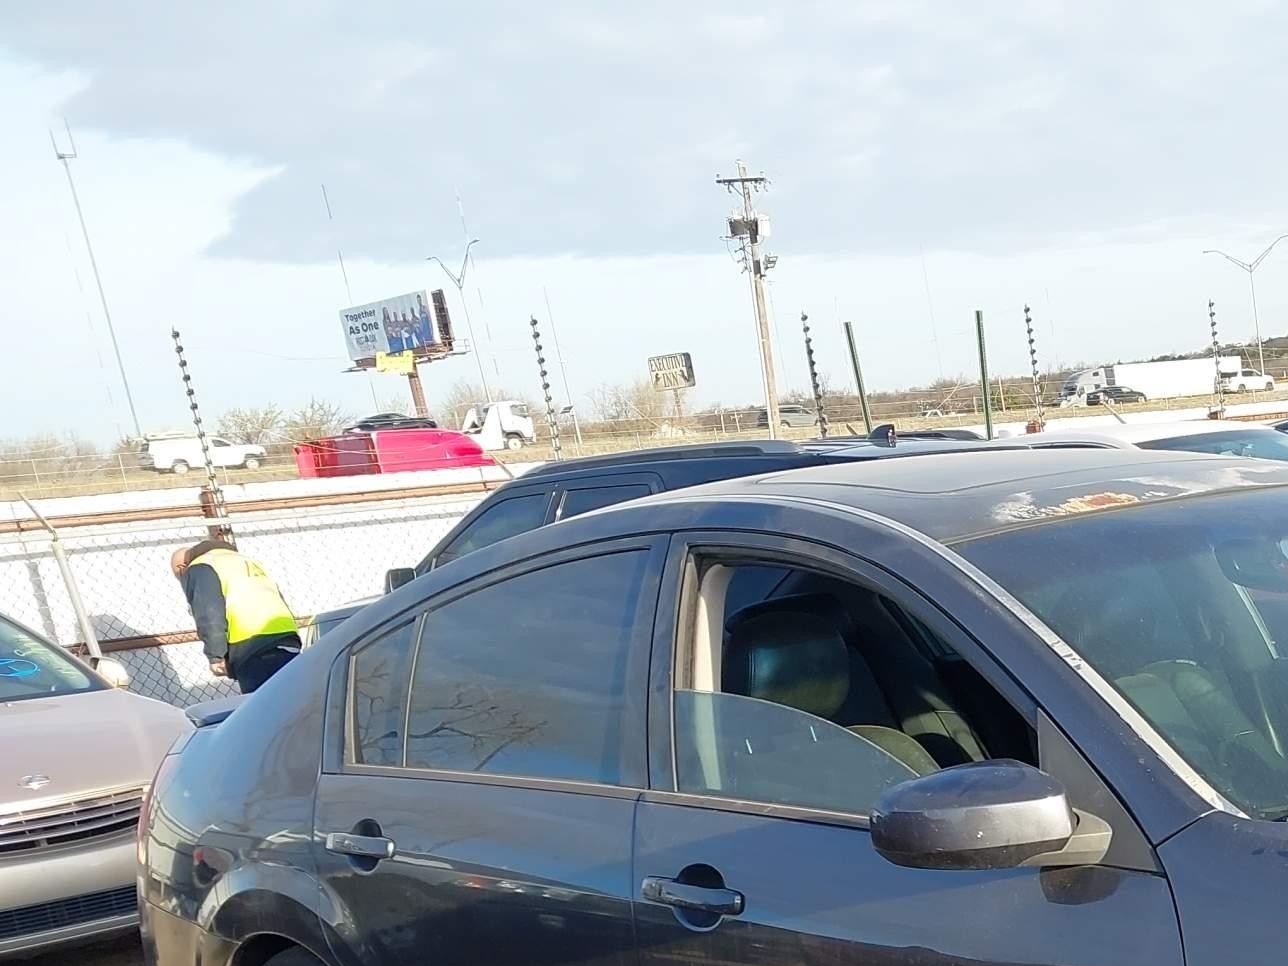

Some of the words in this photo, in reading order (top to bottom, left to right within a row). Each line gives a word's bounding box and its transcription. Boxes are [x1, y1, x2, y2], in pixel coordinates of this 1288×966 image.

[344, 310, 375, 322] Together
[349, 325, 361, 336] As
[361, 322, 379, 332] One
[649, 355, 686, 372] EXECUTIVE
[662, 371, 680, 387] INN
